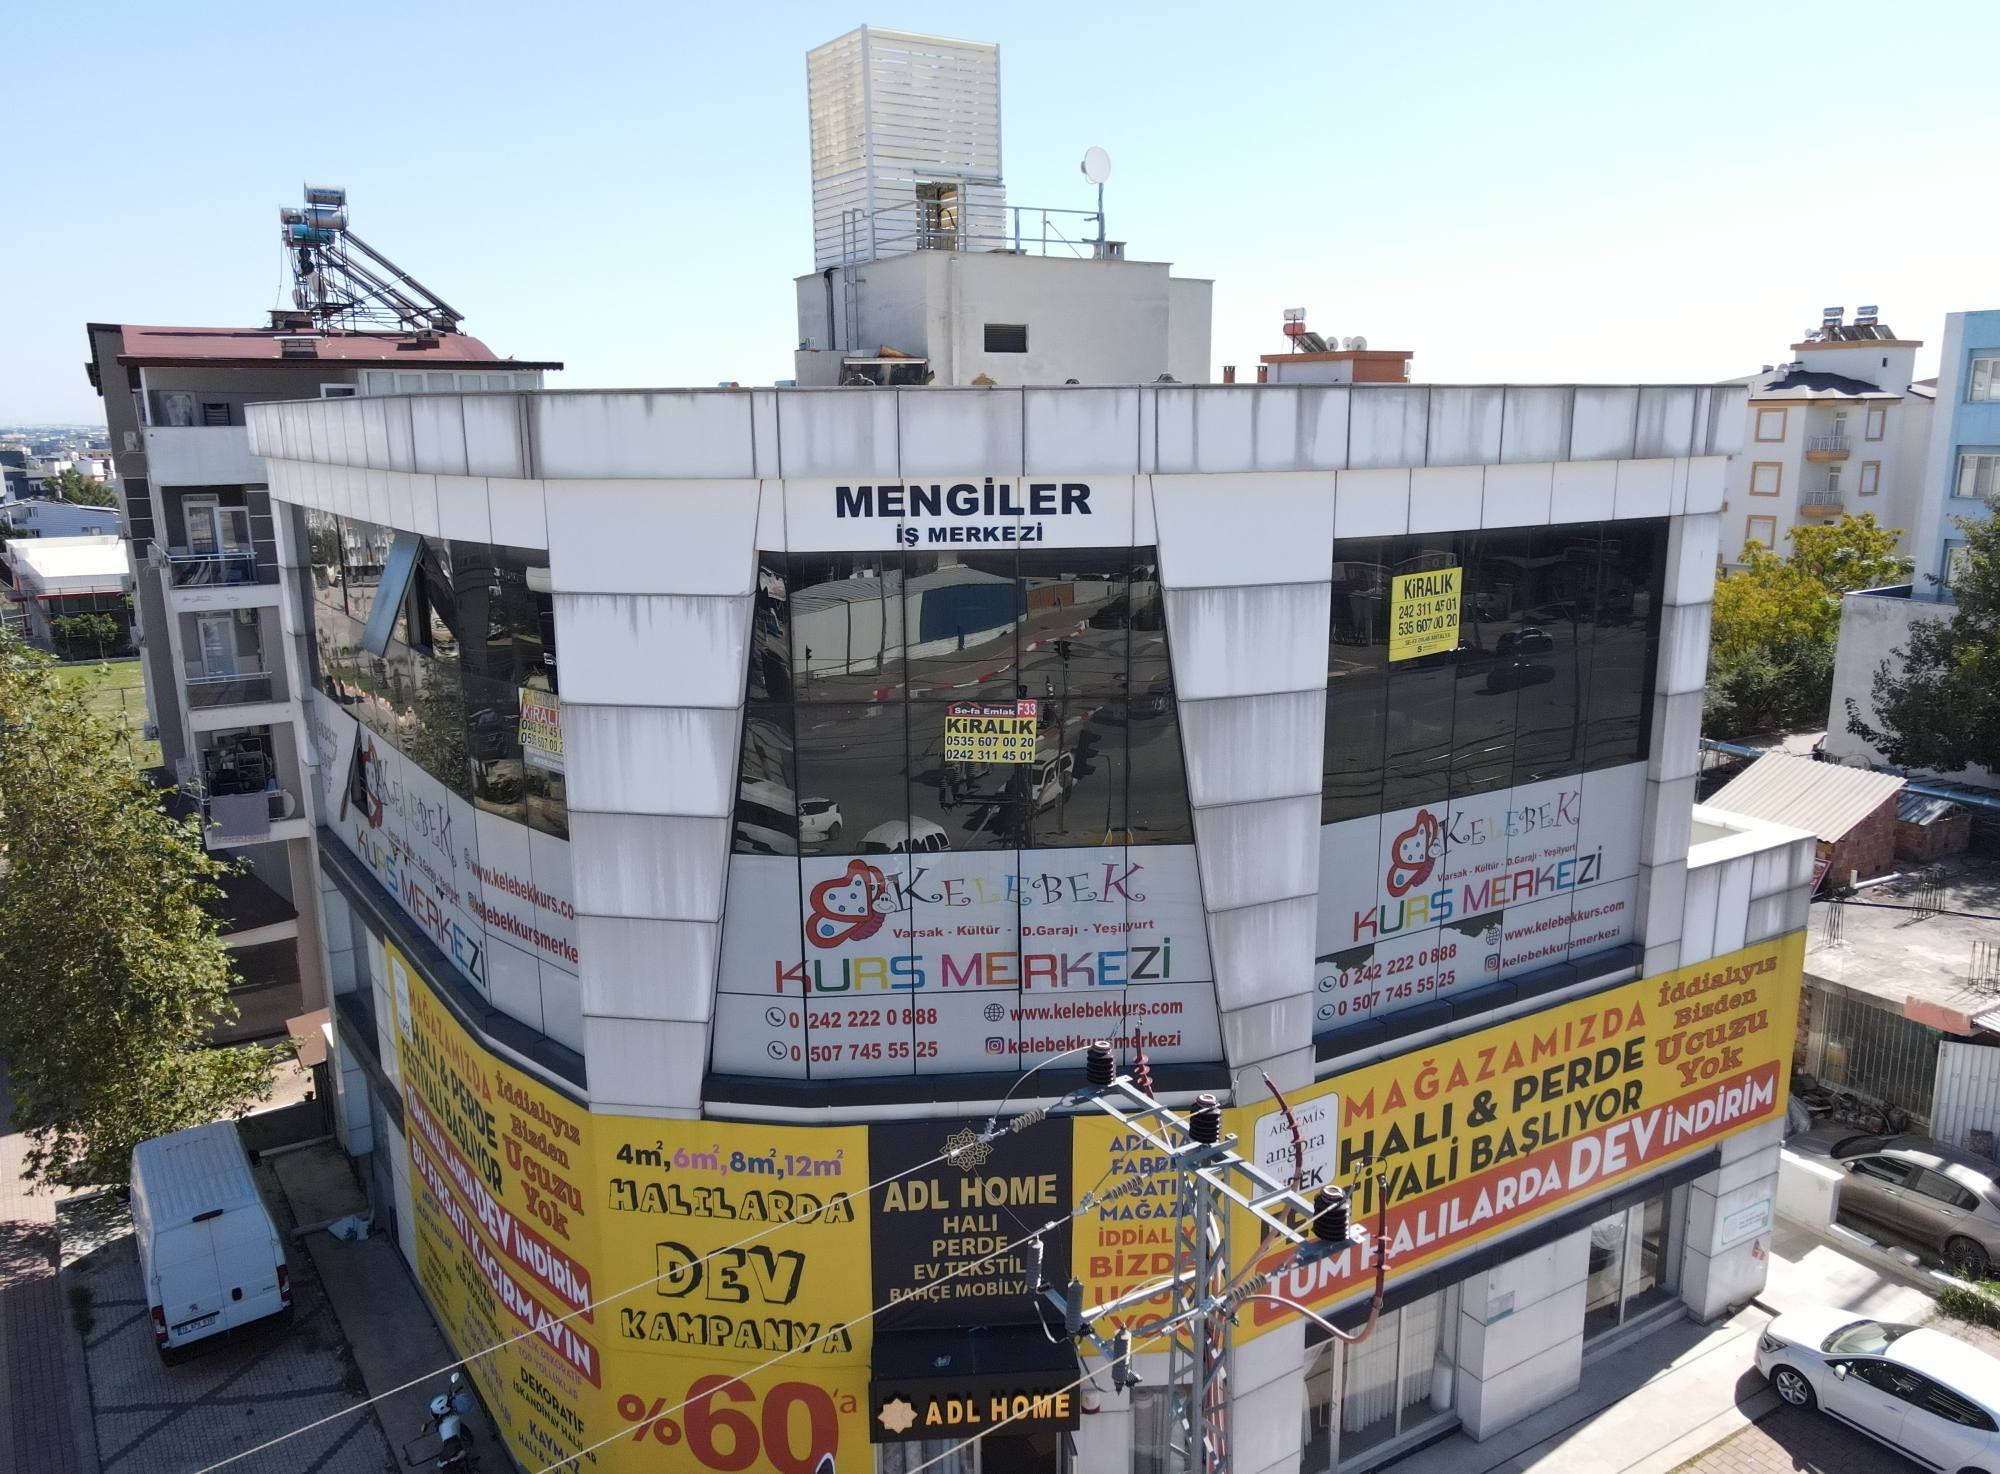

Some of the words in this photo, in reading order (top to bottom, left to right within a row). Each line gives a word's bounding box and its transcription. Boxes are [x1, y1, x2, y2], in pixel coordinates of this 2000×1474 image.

[835, 478, 1092, 518] MENGİLER
[896, 523, 919, 547] İŞ
[928, 522, 1043, 543] MERKEZİ
[1398, 621, 1414, 636] 535
[1416, 619, 1432, 632] 607
[1446, 614, 1458, 627] 20
[1399, 605, 1414, 619] 242
[1416, 602, 1431, 617] 311
[522, 704, 560, 727] KiRALI
[947, 718, 1033, 735] KiRALIK
[983, 707, 1015, 715] Emlak
[1017, 703, 1036, 715] F33
[946, 736, 974, 746] 0535
[978, 737, 999, 747] 607
[1003, 737, 1016, 747] 00
[1020, 737, 1034, 747] 20
[946, 749, 974, 760] 0242
[978, 750, 998, 760] 311
[1002, 751, 1016, 760] 45
[1020, 751, 1033, 760] 01
[1439, 791, 1580, 856] KELEBEK
[471, 859, 575, 920] www.kelebekkurs.co
[887, 862, 1146, 912] KELEBEK
[1353, 888, 1454, 942] KURS
[1463, 845, 1602, 914] MERKEZİ
[400, 868, 487, 988] MERKEZİ
[473, 898, 579, 963] kelebekkursmerke
[892, 927, 943, 939] Varsak
[956, 924, 1000, 937] Kültür
[1092, 919, 1155, 935] Yeşilyurt
[1504, 901, 1625, 942] www.kelebekkurs.com
[775, 955, 926, 993] KURS
[941, 937, 1171, 990] MERKEZİ
[1502, 926, 1620, 969] kelebekkursmerkezi
[1340, 973, 1348, 988] 0
[1354, 964, 1382, 985] 242
[1387, 955, 1414, 976] 222
[1010, 1000, 1183, 1022] www.kelebekkurs.com
[1338, 1001, 1347, 1016] 0
[1353, 991, 1380, 1012] 507
[1386, 982, 1412, 1002] 745
[1417, 976, 1434, 993] 55
[1438, 970, 1455, 987] 25
[1673, 989, 1758, 1029] Bizden
[789, 1012, 799, 1028] 0
[809, 1012, 842, 1029] 242
[848, 1010, 880, 1027] 222
[902, 1008, 938, 1025] 888
[1655, 1009, 1769, 1065] Ucuzu
[790, 1045, 801, 1062] 0
[810, 1045, 843, 1062] 507
[849, 1043, 881, 1060] 745
[888, 1042, 909, 1058] 55
[916, 1041, 938, 1058] 25
[1343, 1000, 1647, 1128] MAĞAZAMIZDA
[1677, 1046, 1743, 1088] Yok
[451, 1068, 498, 1150] PERDE
[1340, 1102, 1452, 1176] HALI
[1466, 1090, 1498, 1128] &
[1512, 1036, 1645, 1113] PERDE
[1470, 1079, 1643, 1173] BAŞLIYOR
[510, 1113, 571, 1170] Bizden
[1568, 1111, 1660, 1190] DEV
[1664, 1074, 1774, 1147] İNDİRİM
[502, 1132, 585, 1216] Ucuzu
[883, 1178, 948, 1213] ADL
[961, 1174, 1057, 1208] HOME
[521, 1179, 571, 1241] Yok
[608, 1178, 855, 1225] HALILARDA
[475, 1176, 511, 1251] DEV
[514, 1220, 590, 1313] İNDİRİM
[943, 1214, 998, 1234] HALI
[914, 1263, 940, 1280] EV
[944, 1254, 1026, 1277] TEKSTİL
[932, 1236, 1008, 1258] PERDE
[656, 1241, 806, 1305] DEV
[890, 1284, 950, 1302] BAHÇE
[620, 1308, 853, 1353] KAMPANYA
[521, 1366, 585, 1435] DEKORATİF
[926, 1400, 980, 1426] ADL
[991, 1393, 1070, 1422] HOME
